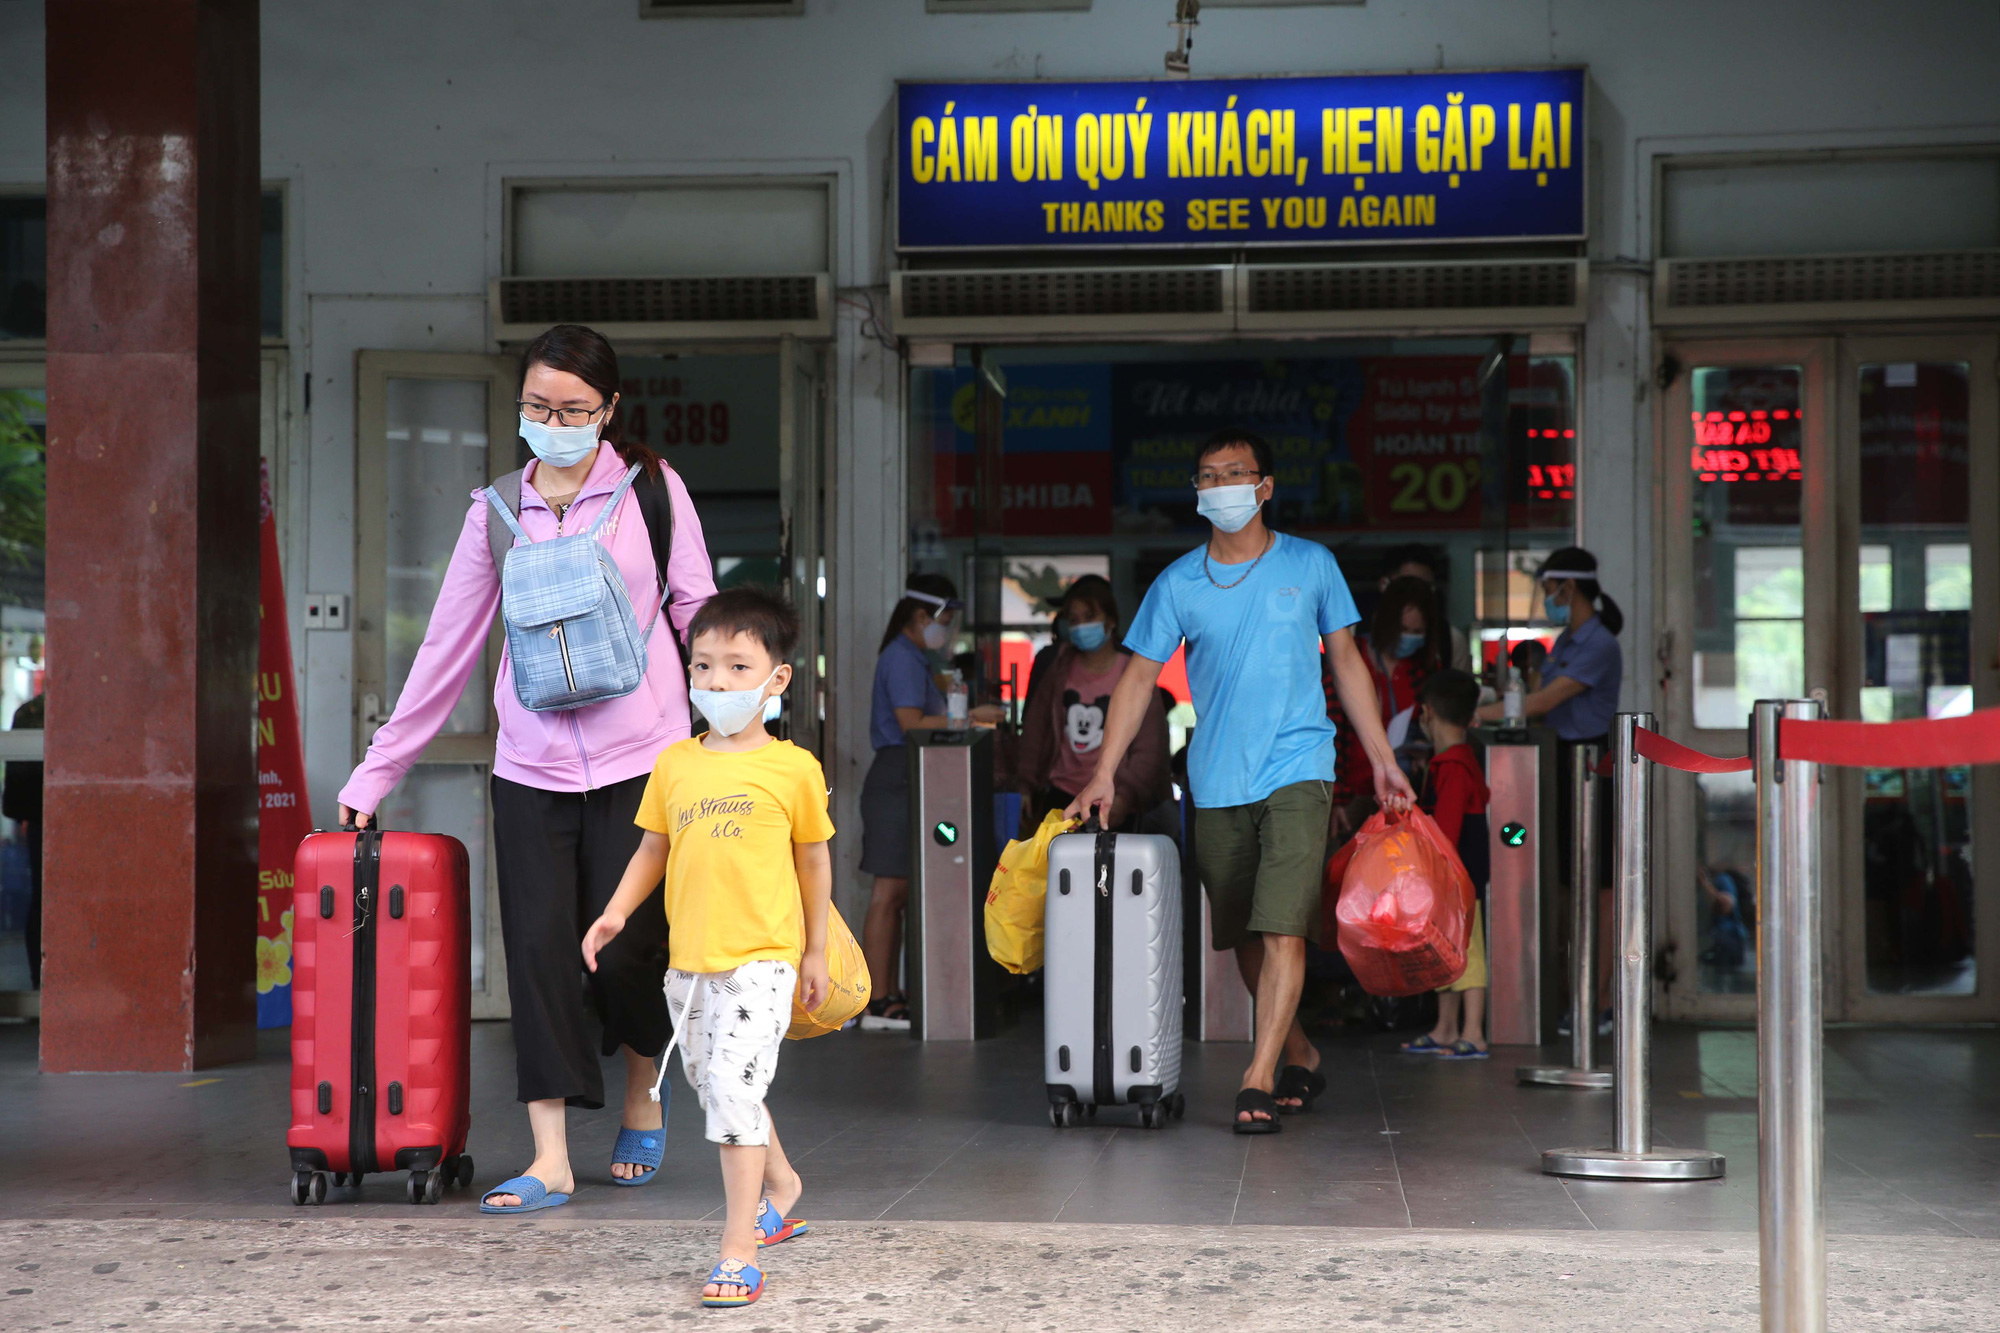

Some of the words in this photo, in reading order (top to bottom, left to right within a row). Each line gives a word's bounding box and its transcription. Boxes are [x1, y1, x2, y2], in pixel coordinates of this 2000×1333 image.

[911, 101, 998, 183] CÁM
[1010, 104, 1063, 182] ƠN
[1075, 97, 1153, 190] QUÝ
[1167, 95, 1309, 186] KHÁCH,
[1322, 106, 1403, 191] HẸN
[1415, 92, 1496, 188] GẶP
[1508, 102, 1572, 187] LẠI
[1042, 199, 1165, 233] THANKS
[1186, 199, 1250, 230] SEE
[1262, 197, 1327, 229] YOU
[1338, 195, 1436, 228] AGAIN
[664, 401, 729, 445] 389
[1006, 405, 1092, 428] XANH
[259, 717, 275, 746] N
[259, 770, 282, 787] inh,
[265, 792, 295, 808] 2021
[698, 794, 755, 820] Strauss
